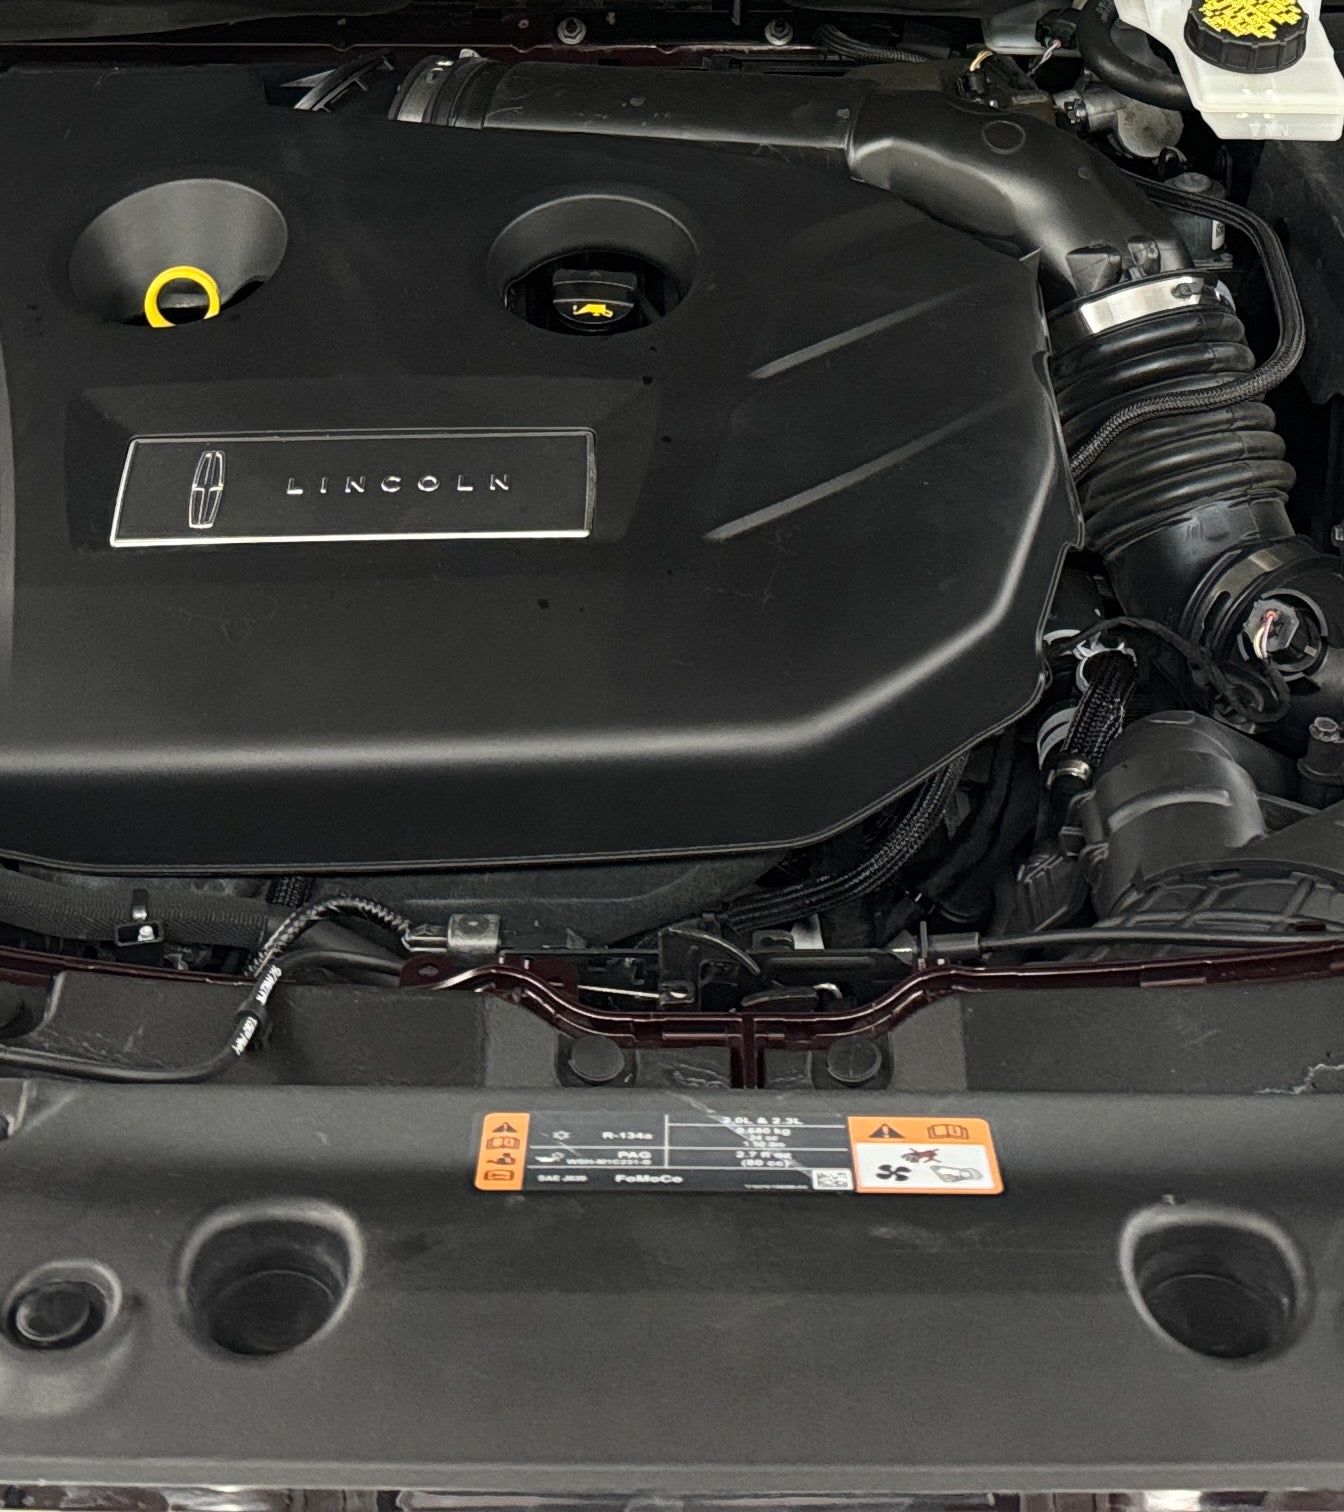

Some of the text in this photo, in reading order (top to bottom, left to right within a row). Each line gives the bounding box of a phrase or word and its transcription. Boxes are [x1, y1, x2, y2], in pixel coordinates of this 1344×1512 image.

[286, 474, 510, 495] LINCOLN
[601, 1131, 654, 1141] R-134a
[617, 1150, 652, 1159] PAG
[614, 1173, 684, 1184] FoMoCo
